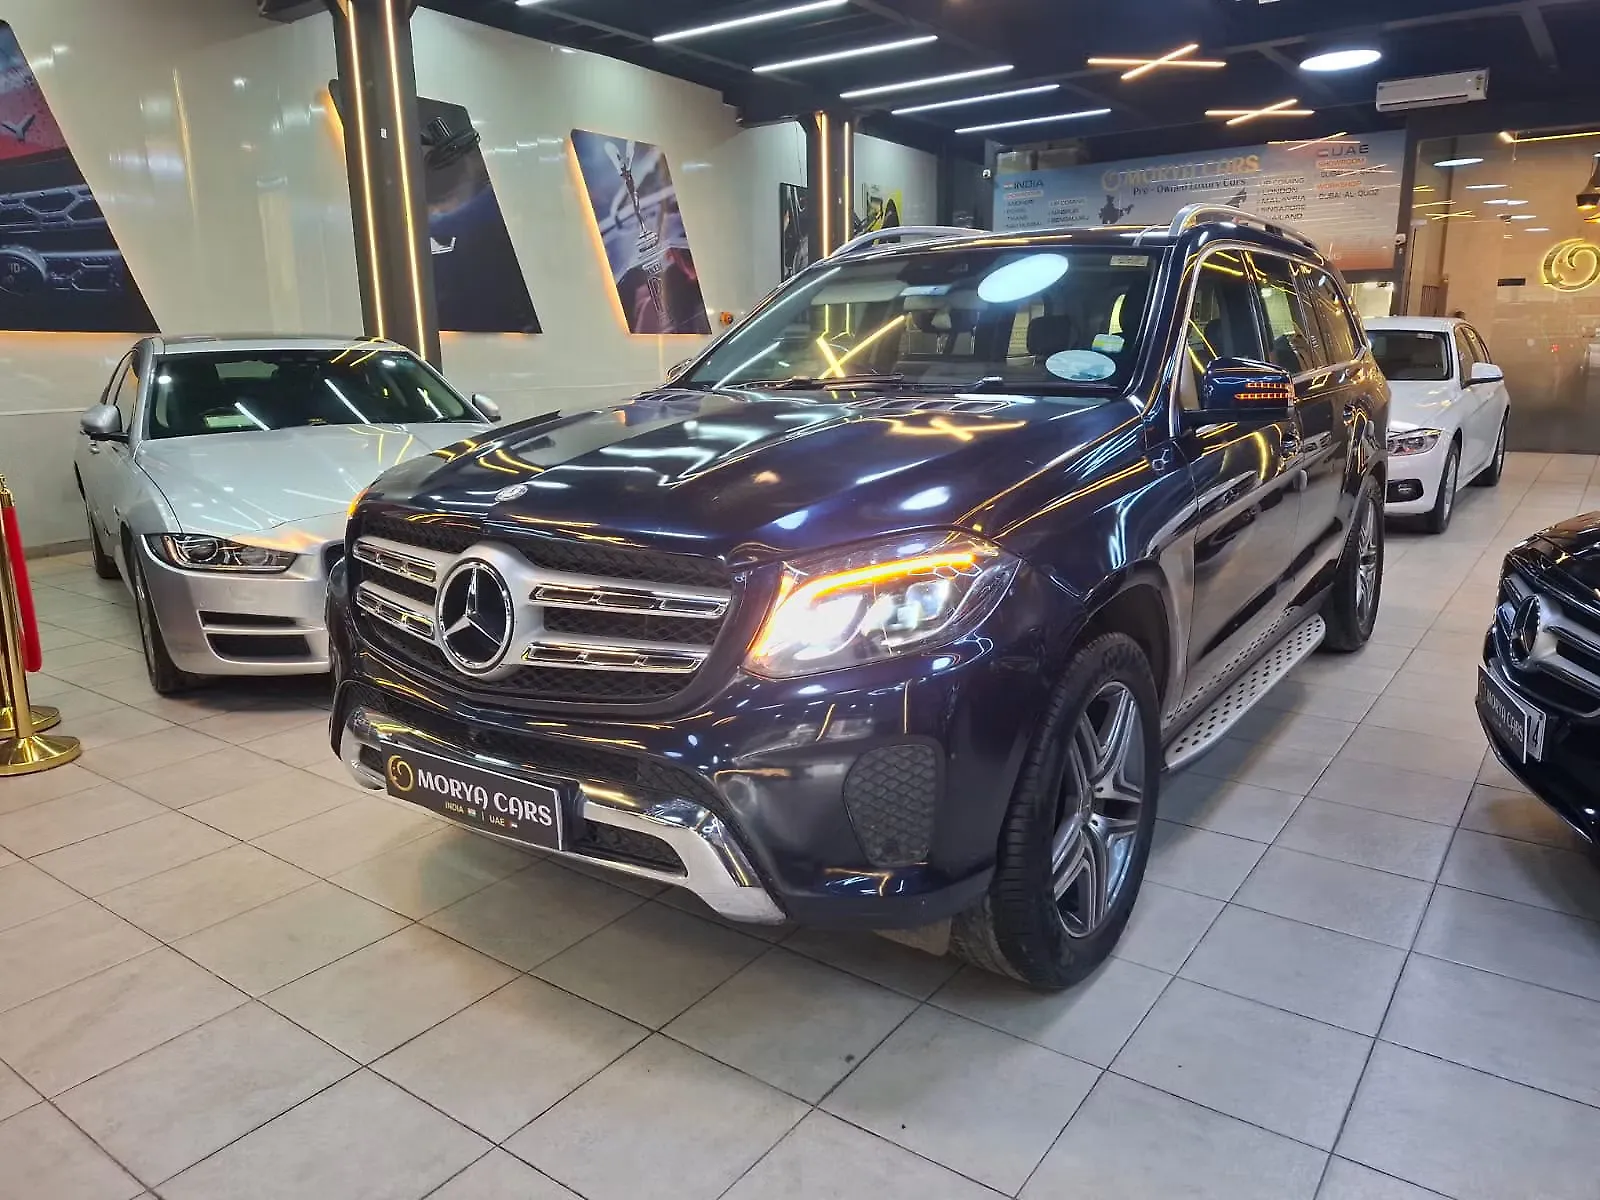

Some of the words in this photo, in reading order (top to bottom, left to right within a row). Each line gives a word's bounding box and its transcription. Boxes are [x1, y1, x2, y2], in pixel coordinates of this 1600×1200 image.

[1332, 144, 1369, 156] UAE
[1014, 180, 1044, 190] INDIA
[418, 768, 489, 811] MORYA
[493, 791, 552, 827] CARS
[445, 801, 465, 815] INDIA
[489, 815, 505, 827] UAE
